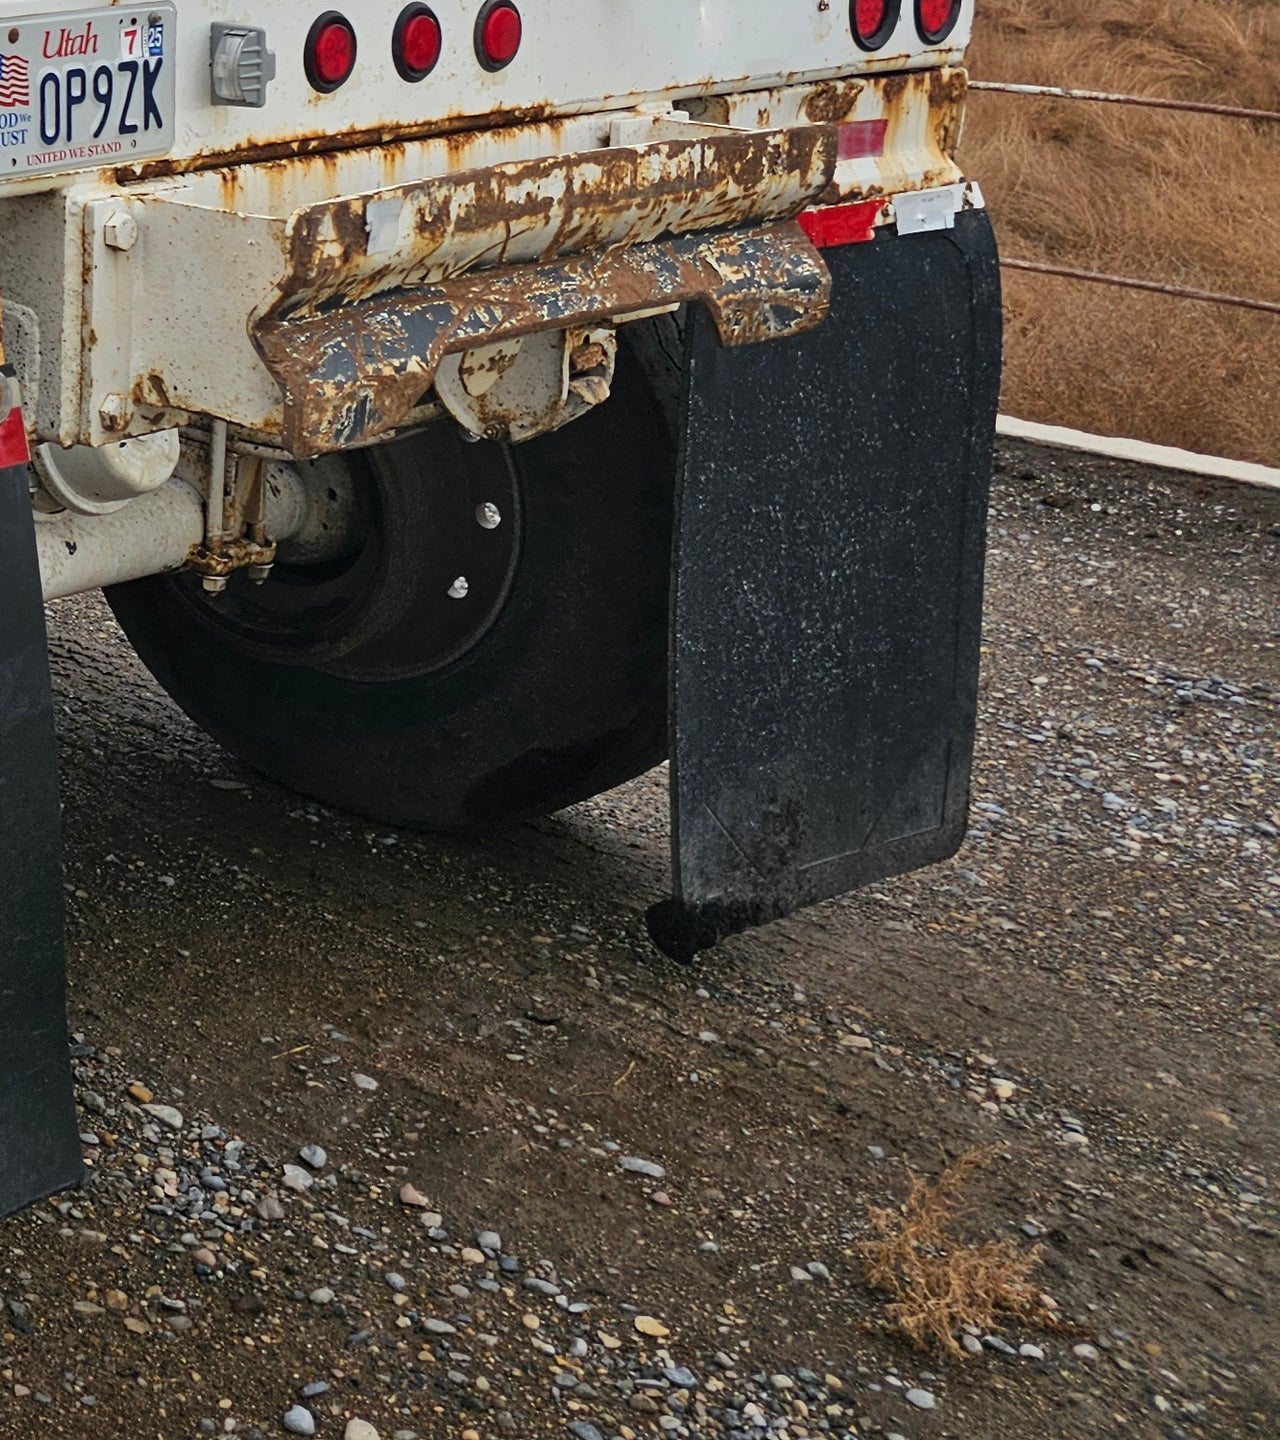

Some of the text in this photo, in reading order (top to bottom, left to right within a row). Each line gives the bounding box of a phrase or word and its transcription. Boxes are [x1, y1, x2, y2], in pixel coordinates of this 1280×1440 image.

[42, 21, 98, 59] Utah
[124, 29, 138, 55] 7
[148, 27, 162, 48] 25
[19, 113, 32, 123] We
[26, 141, 122, 166] UNITED WE STAND
